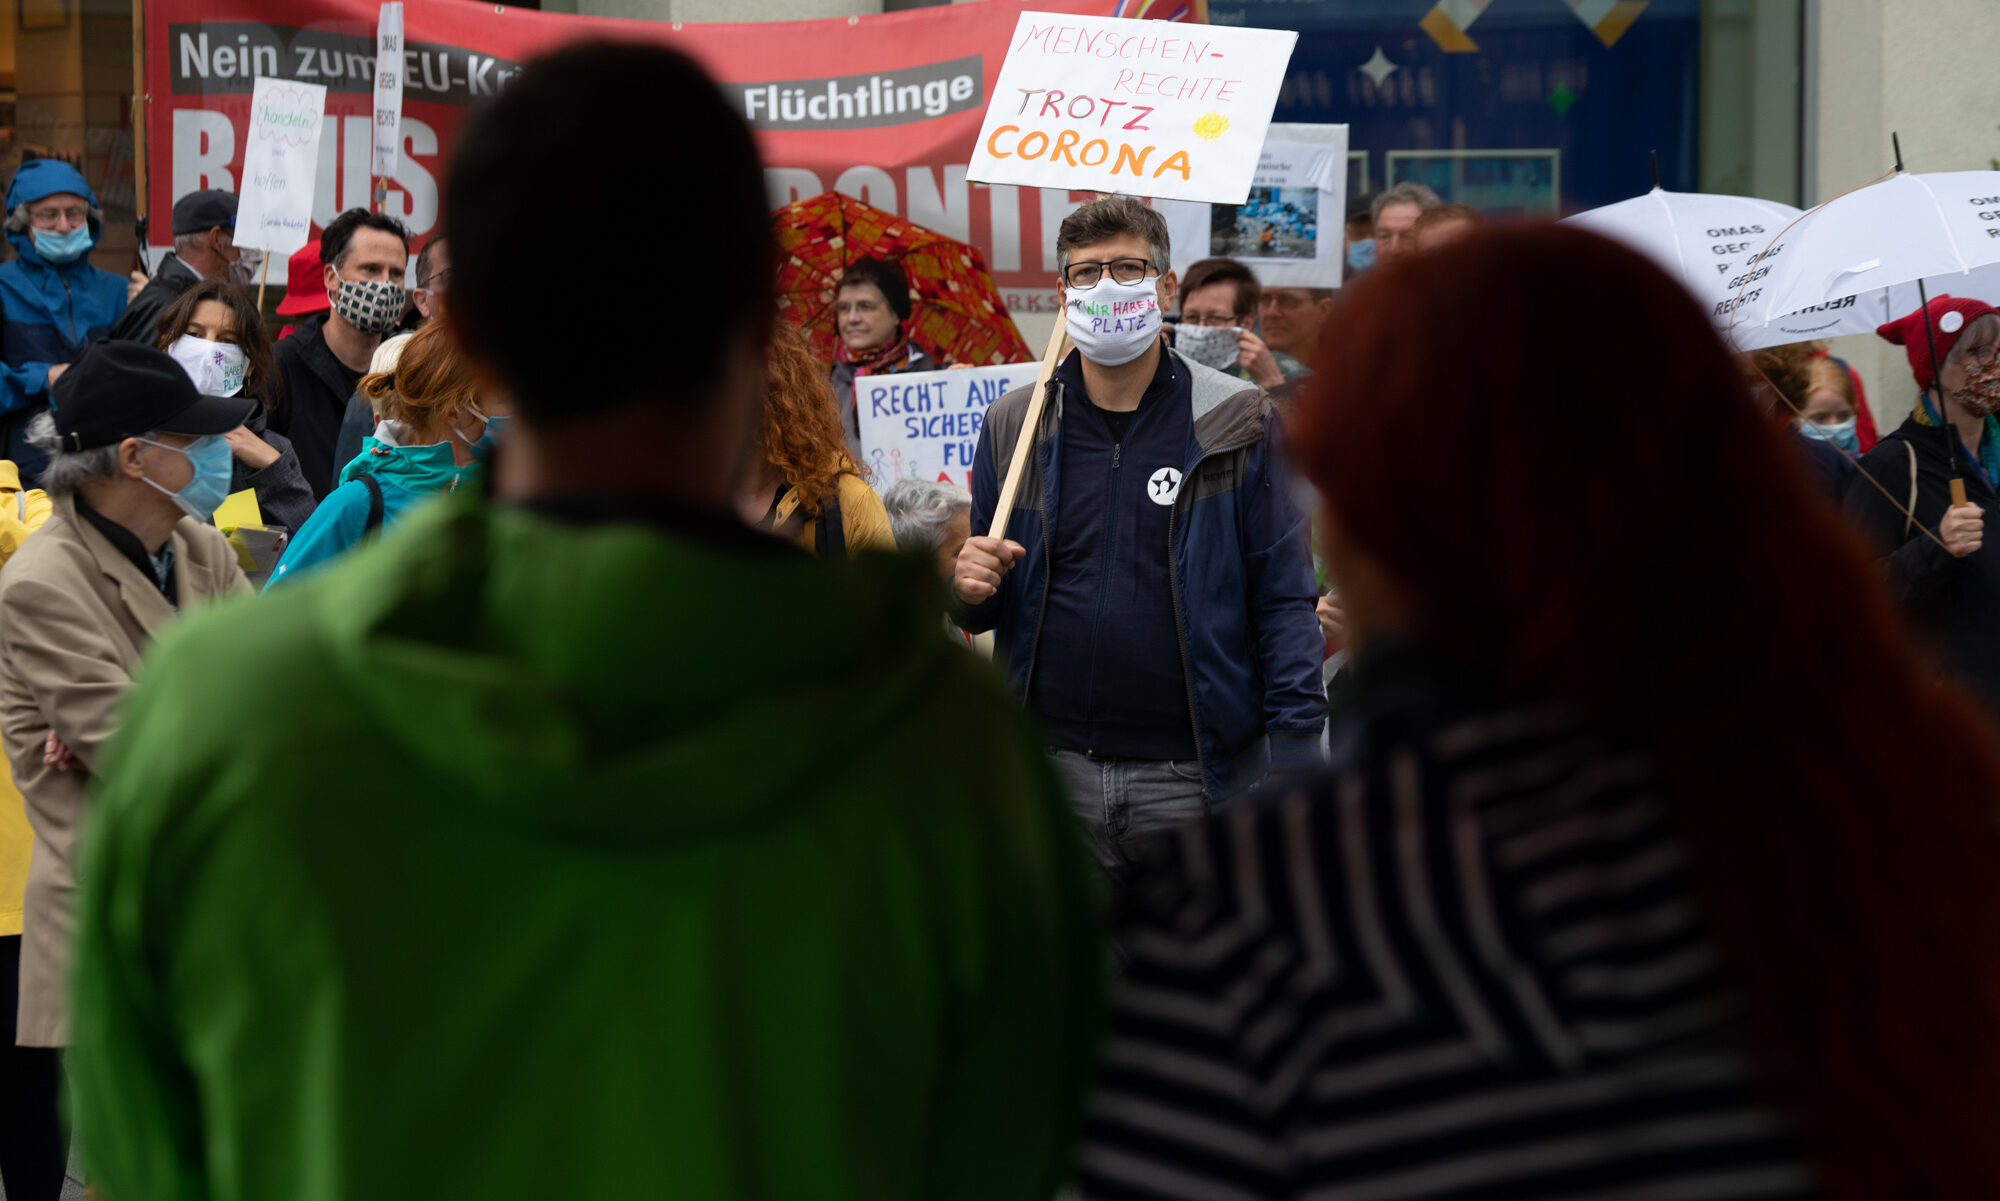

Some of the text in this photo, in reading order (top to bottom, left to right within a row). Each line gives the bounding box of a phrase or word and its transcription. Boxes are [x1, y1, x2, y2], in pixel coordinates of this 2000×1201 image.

[180, 32, 278, 79] Nein
[382, 35, 397, 51] OMAS
[1017, 24, 1225, 63] MENSCHEN-
[379, 71, 396, 90] GEGEN
[1113, 67, 1242, 102] RECHTE
[744, 73, 975, 121] Flüchtlinge
[1017, 88, 1155, 131] TROTZ
[263, 105, 310, 129] handeln
[986, 124, 1193, 181] CORONA
[172, 109, 439, 236] RUS
[1706, 223, 1766, 238] OMAS
[1746, 243, 1785, 266] OMAS
[1728, 264, 1774, 290] GEGEN
[1082, 300, 1111, 317] WIR
[1113, 298, 1156, 317] HABEN
[1713, 287, 1763, 317] RECHTS
[1091, 314, 1147, 333] PLATZ
[871, 378, 1011, 418] RECHT AUF
[905, 412, 982, 439] SICHER
[943, 439, 974, 467] FÜ
